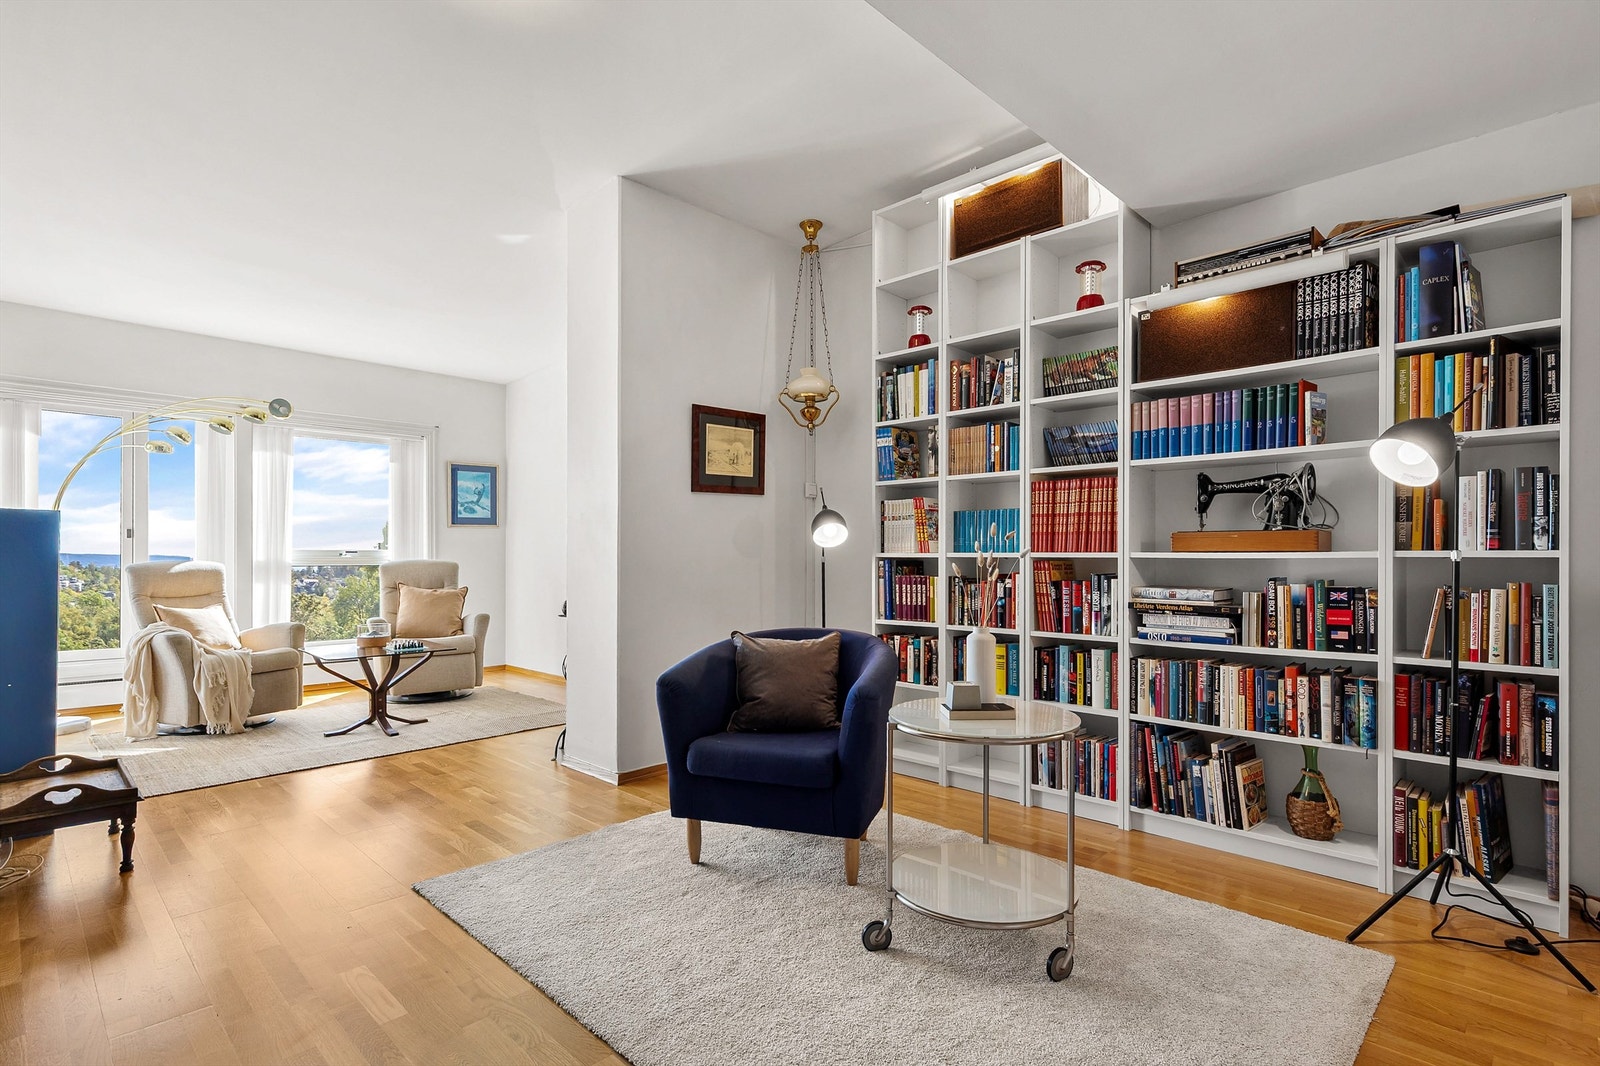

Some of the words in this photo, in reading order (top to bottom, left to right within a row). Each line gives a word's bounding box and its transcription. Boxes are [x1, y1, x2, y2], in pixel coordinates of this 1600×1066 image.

[1313, 276, 1321, 299] NORGE
[1422, 275, 1450, 286] CAPLEX
[1313, 303, 1321, 319] KRIG
[1522, 358, 1530, 382] NORGES
[1522, 382, 1530, 411] HISTORIE
[1182, 427, 1187, 435] 2
[1257, 421, 1262, 429] 2
[1268, 580, 1276, 600] USAIN
[1092, 591, 1100, 612] FORSYTH
[1268, 599, 1276, 616] BOLT
[1147, 632, 1167, 641] OSLO
[1547, 635, 1555, 661] TERBOVEN
[1198, 666, 1207, 689] Mykle
[1434, 714, 1444, 744] MOREN
[1545, 732, 1553, 756] LARSSON
[1394, 796, 1404, 812] NEIL
[1395, 813, 1404, 834] YOUNG
[1480, 845, 1490, 872] ALASKA
